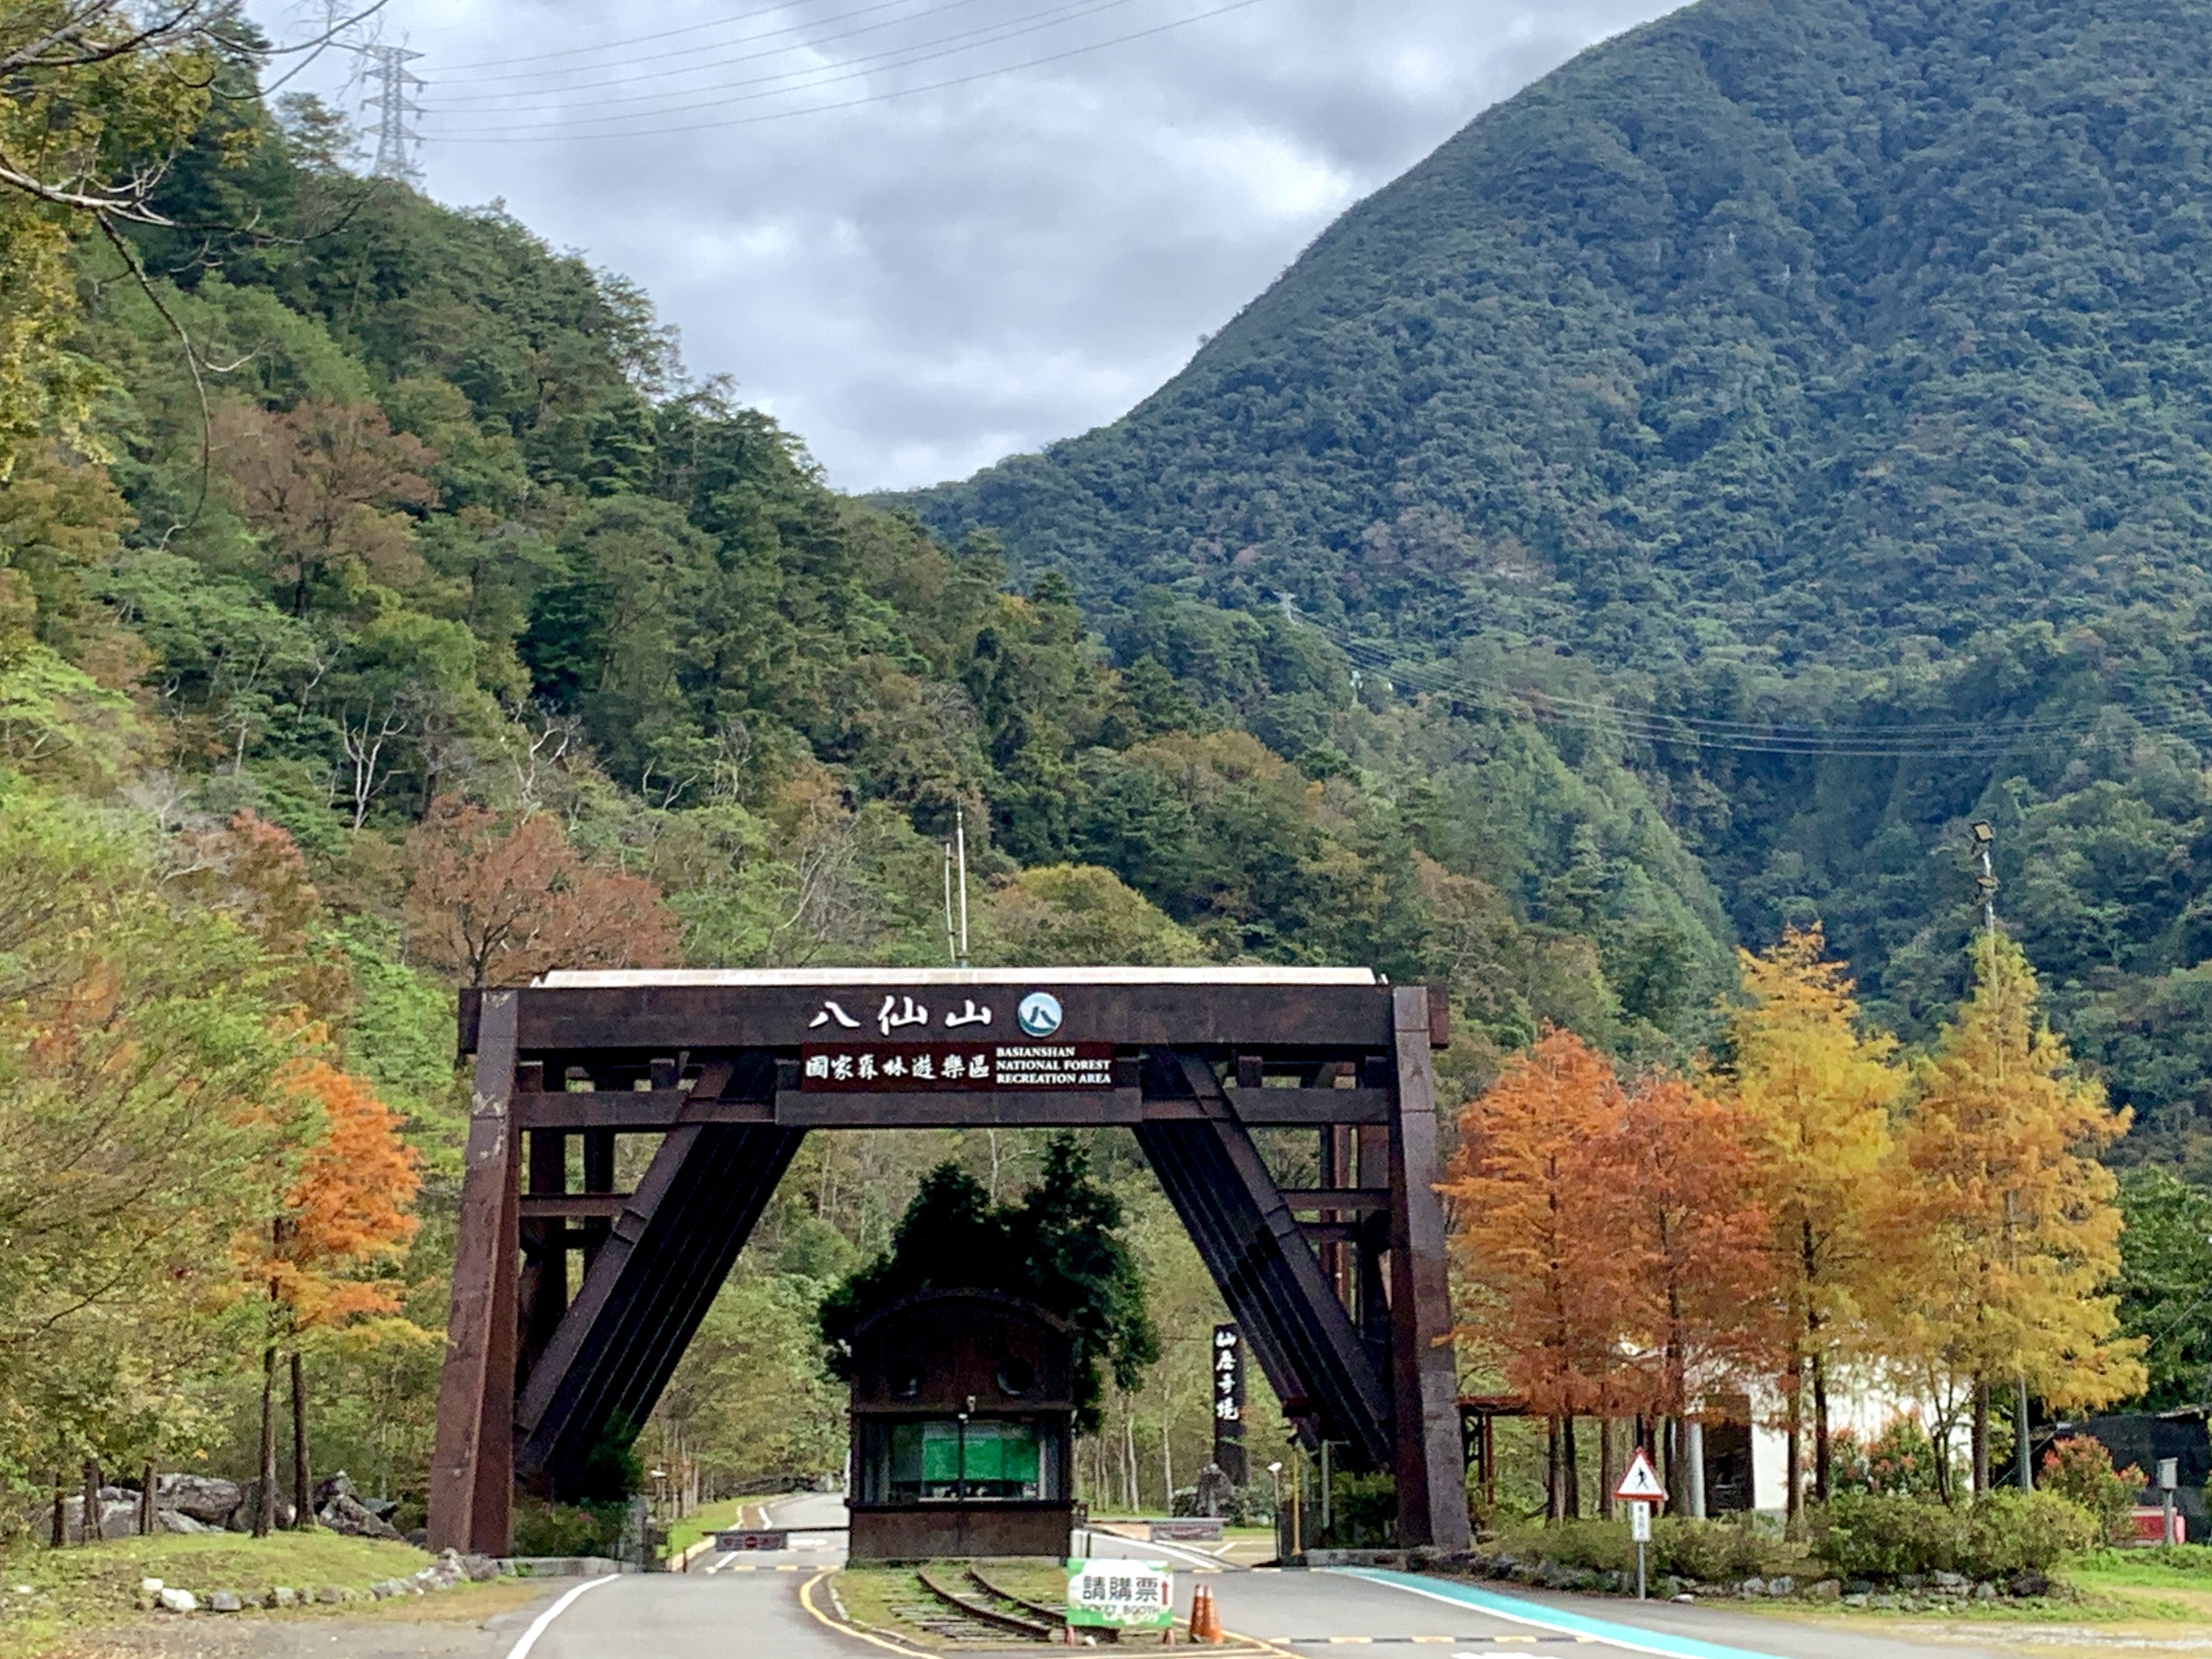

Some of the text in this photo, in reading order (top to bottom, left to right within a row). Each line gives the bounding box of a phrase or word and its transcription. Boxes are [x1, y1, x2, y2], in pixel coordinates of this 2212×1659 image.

[808, 995, 992, 1036] 八仙山
[996, 1046, 1075, 1057] BASIANSHAN
[805, 1054, 990, 1080] 國家森林遊樂區
[996, 1060, 1112, 1070] NATIONAL FOREST
[996, 1073, 1112, 1084] RECREATION AREA
[1083, 1575, 1158, 1602] 請購票
[1123, 1605, 1160, 1615] BOOTH
